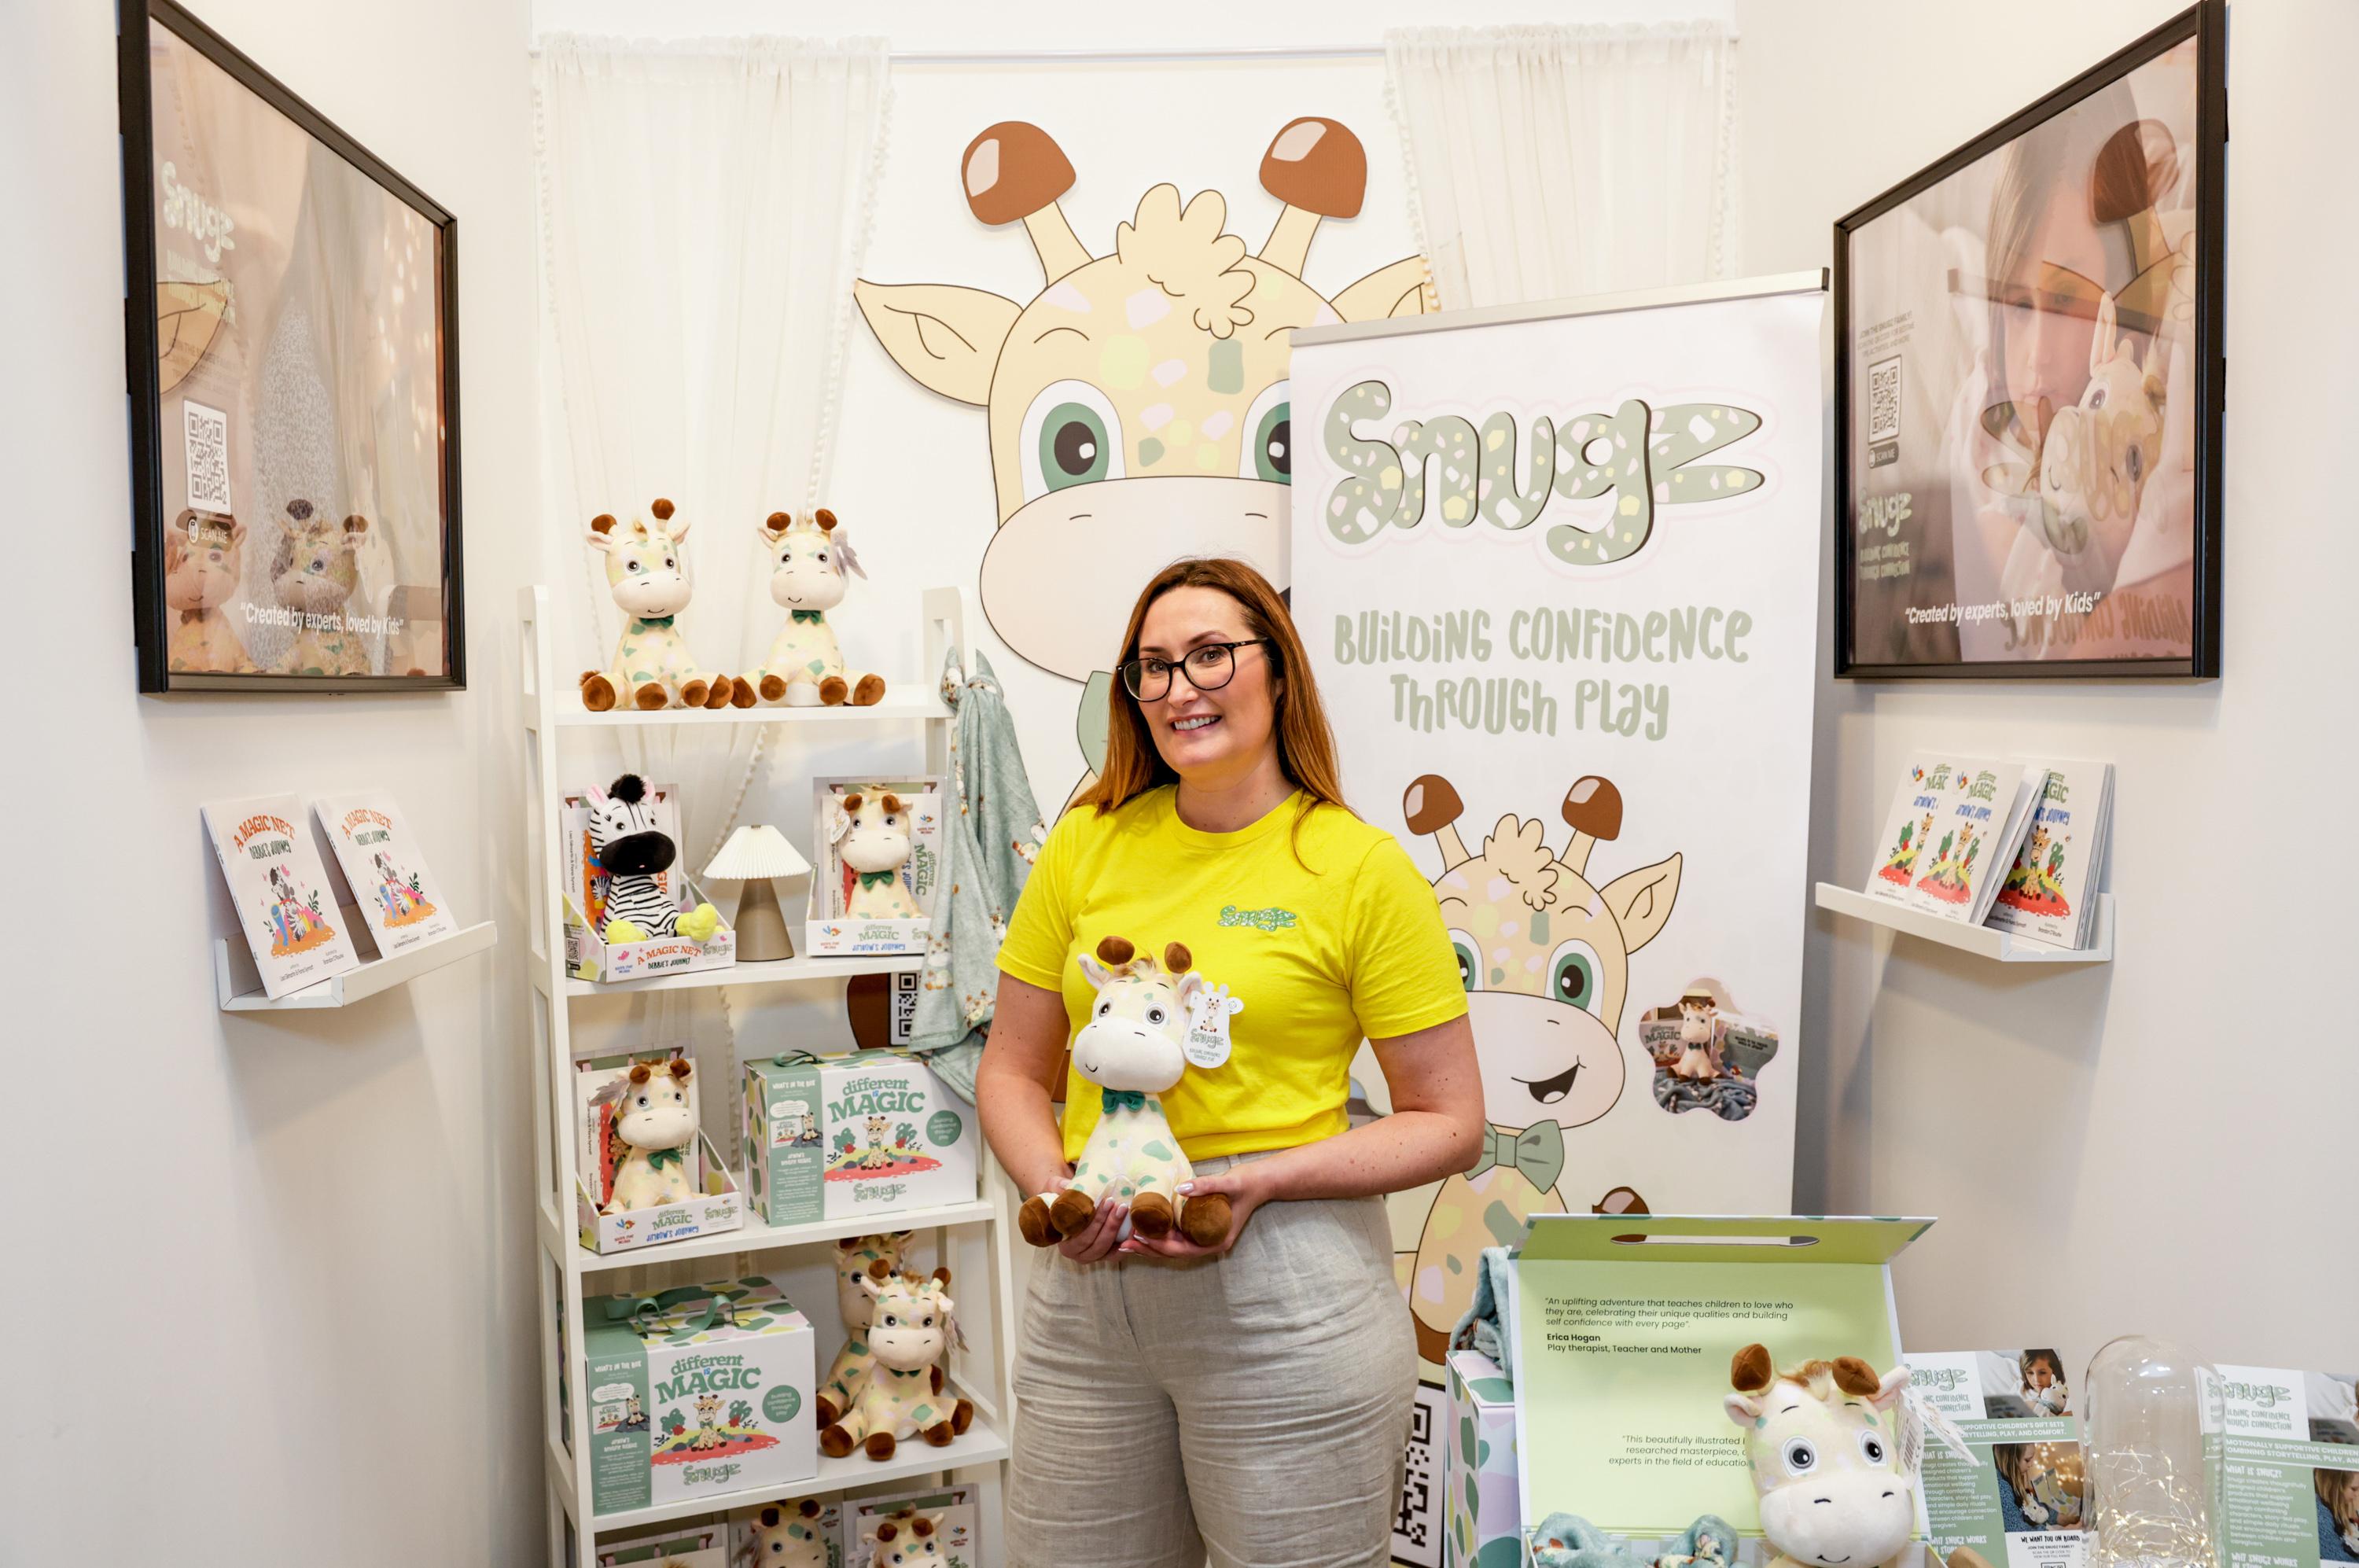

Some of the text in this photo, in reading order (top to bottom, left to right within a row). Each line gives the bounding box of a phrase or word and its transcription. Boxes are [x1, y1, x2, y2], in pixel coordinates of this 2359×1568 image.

[1323, 380, 1766, 565] Snugz
[218, 531, 227, 544] ME
[1949, 602, 1962, 627] by
[1965, 600, 2008, 626] experts,
[2011, 595, 2044, 617] loved
[2046, 593, 2063, 621] by
[292, 606, 304, 634] by
[306, 612, 344, 635] experts,
[345, 613, 370, 633] loved
[371, 615, 381, 639] by
[345, 809, 370, 830] MAGIC
[234, 815, 296, 853] A MAGIC NET
[341, 824, 351, 840] A
[915, 843, 928, 896] MAGIC
[1217, 905, 1297, 932] Snugz
[858, 930, 900, 941] MAGIC
[637, 945, 701, 966] A MAGIC NET
[648, 959, 669, 970] DEBBIE'S
[1190, 1029, 1224, 1049] Snugz
[1644, 1032, 1681, 1044] MAGIC
[842, 1077, 909, 1096] different
[827, 1091, 926, 1123] MAGIC
[853, 1183, 906, 1202] Snugz
[705, 1206, 738, 1220] Snugz
[653, 1214, 692, 1230] MAGIC
[1562, 1297, 1598, 1308] uplifting
[1705, 1300, 1741, 1309] children
[1545, 1308, 1566, 1317] they
[1585, 1309, 1636, 1319] celebrating
[1660, 1310, 1691, 1320] unique
[1692, 1310, 1730, 1320] qualities
[1752, 1312, 1788, 1321] building
[1563, 1318, 1612, 1327] confidence
[1615, 1319, 1633, 1327] with
[1636, 1320, 1660, 1330] every
[1571, 1334, 1601, 1343] Hogan
[1548, 1343, 1566, 1353] Play
[1568, 1344, 1610, 1354] therapist,
[671, 1354, 744, 1376] different
[654, 1367, 761, 1404] MAGIC
[2251, 1409, 2290, 1421] CONFIDENCE
[1622, 1434, 1740, 1446] "This beautifully illustrated
[2226, 1439, 2273, 1449] MOTIONALLY
[2274, 1444, 2320, 1453] SUPPORTIVE
[1626, 1446, 1739, 1458] researched masterpiece,
[1938, 1451, 1944, 1459] IS
[2227, 1448, 2265, 1456] OMBINING
[1609, 1457, 1642, 1466] experts
[1644, 1456, 1653, 1465] in
[1655, 1457, 1670, 1466] the
[1673, 1457, 1692, 1466] field
[1706, 1458, 1749, 1467] educatio
[683, 1463, 742, 1486] Snugz
[2227, 1465, 2245, 1475] WHAT
[2247, 1466, 2254, 1475] IS
[1966, 1535, 1987, 1544] WORKS
